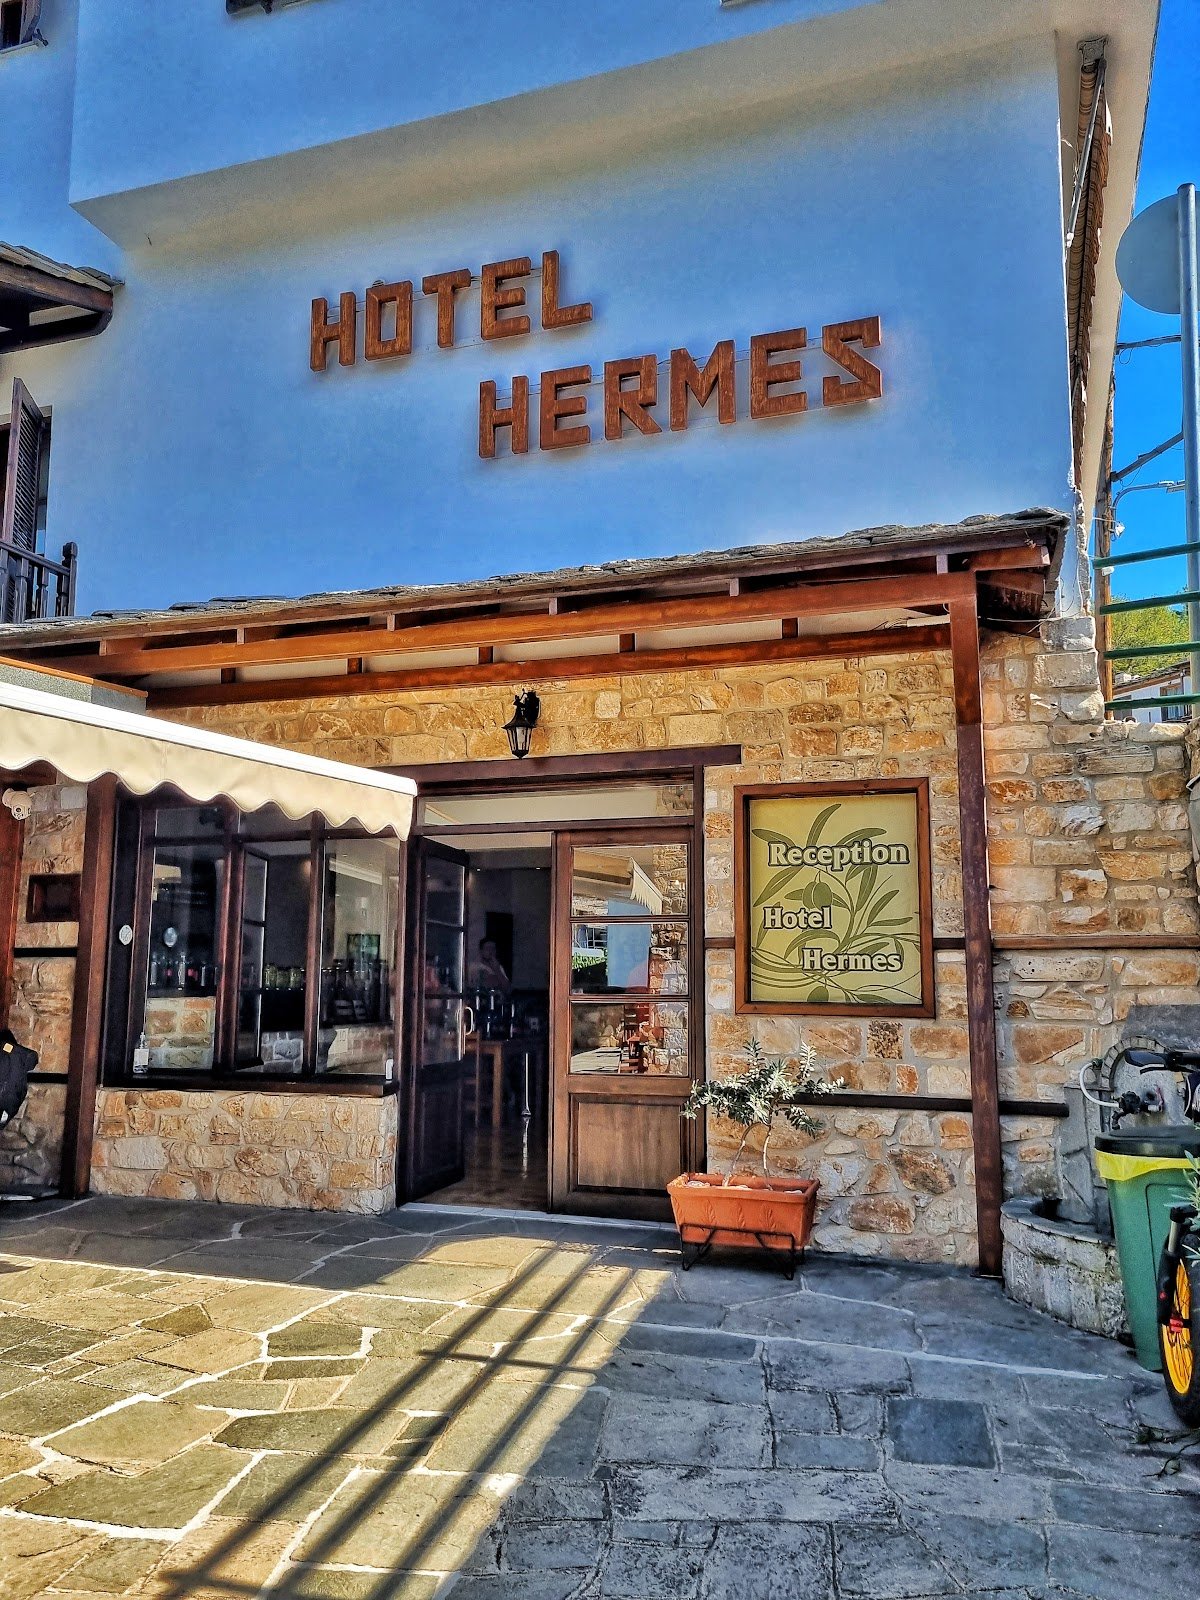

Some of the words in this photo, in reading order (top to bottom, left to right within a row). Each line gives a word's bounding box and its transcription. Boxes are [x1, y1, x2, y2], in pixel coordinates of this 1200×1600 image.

[310, 250, 592, 371] HOTEL
[479, 315, 882, 459] HERMES
[768, 838, 909, 871] Reception
[763, 906, 832, 929] Hotel
[802, 947, 903, 972] Hermes
